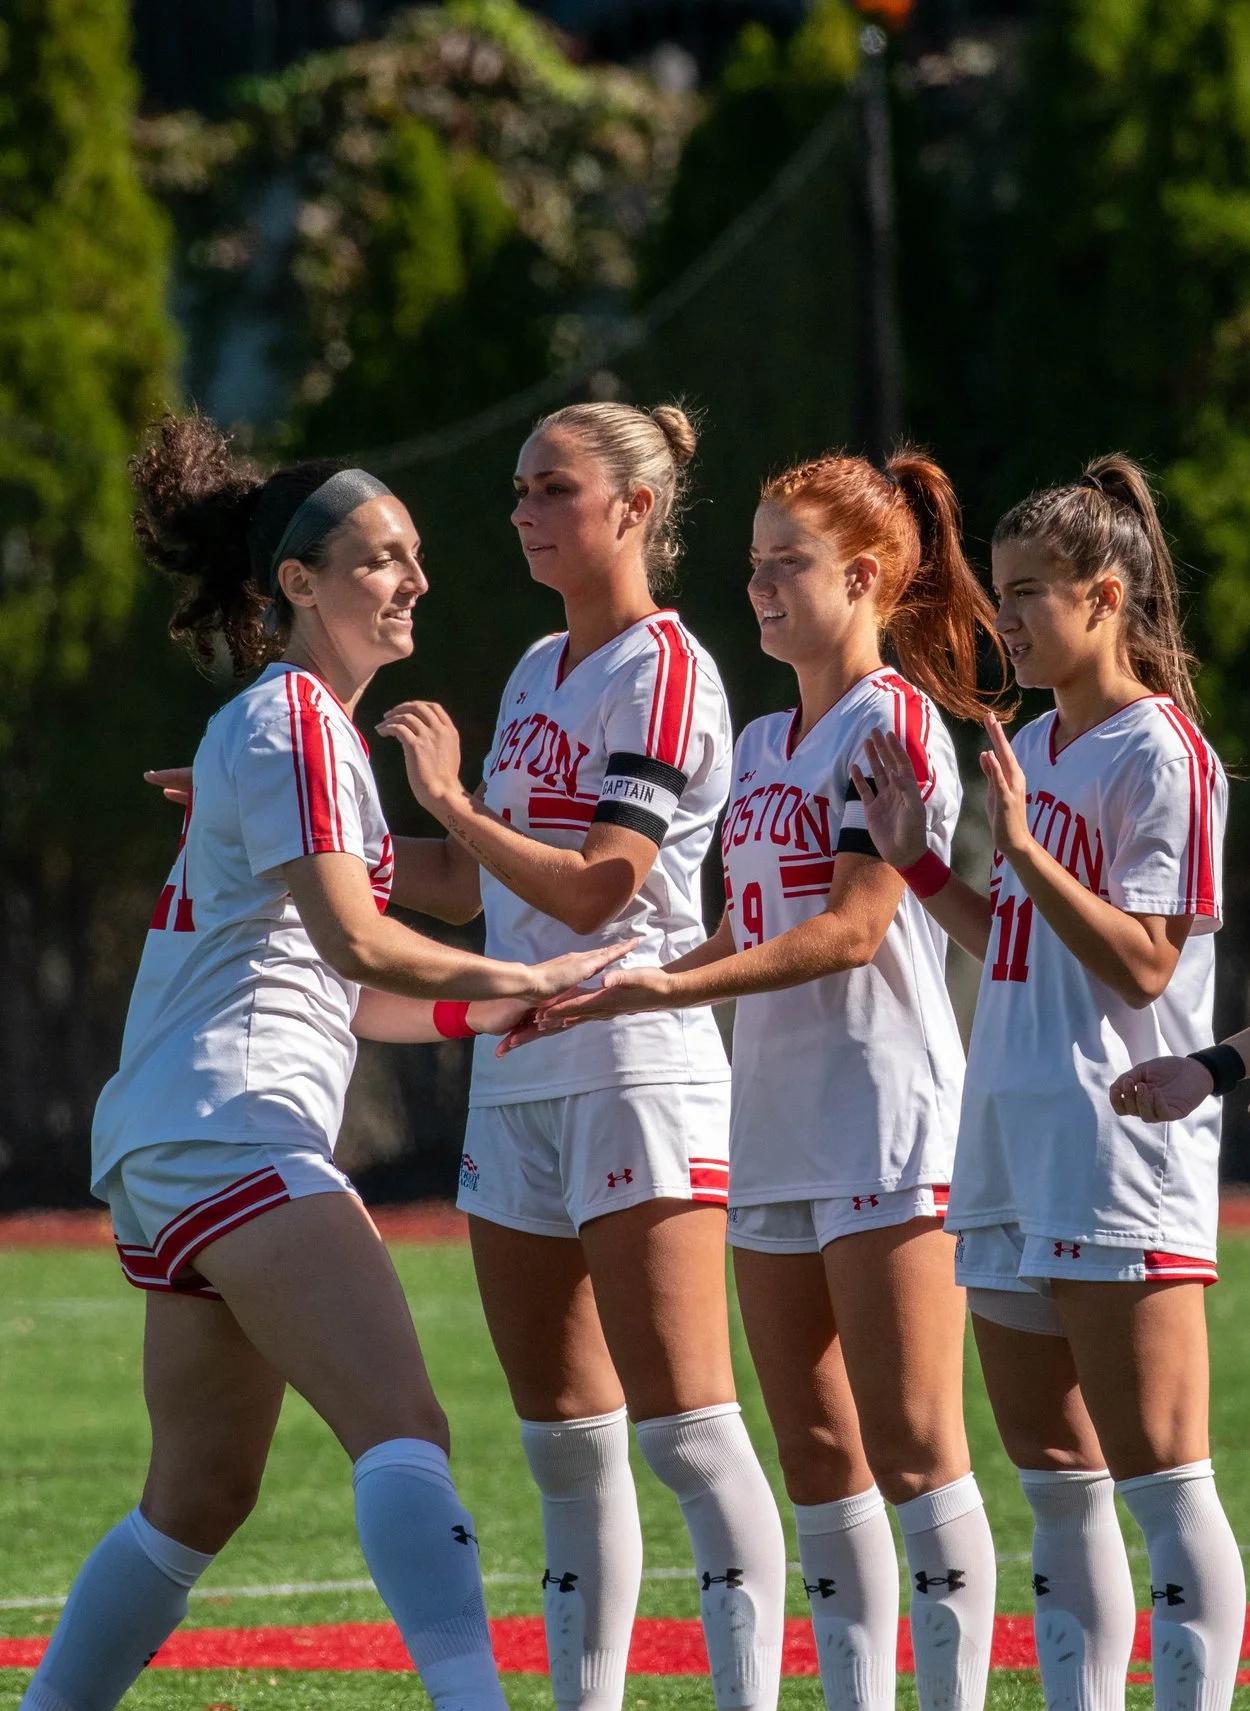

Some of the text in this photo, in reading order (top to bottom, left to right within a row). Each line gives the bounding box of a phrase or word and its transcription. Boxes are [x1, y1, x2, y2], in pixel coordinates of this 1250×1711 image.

[489, 713, 590, 800] OSTON
[602, 779, 655, 803] CAPTAIN
[742, 881, 763, 950] 9
[992, 895, 1034, 982] 11
